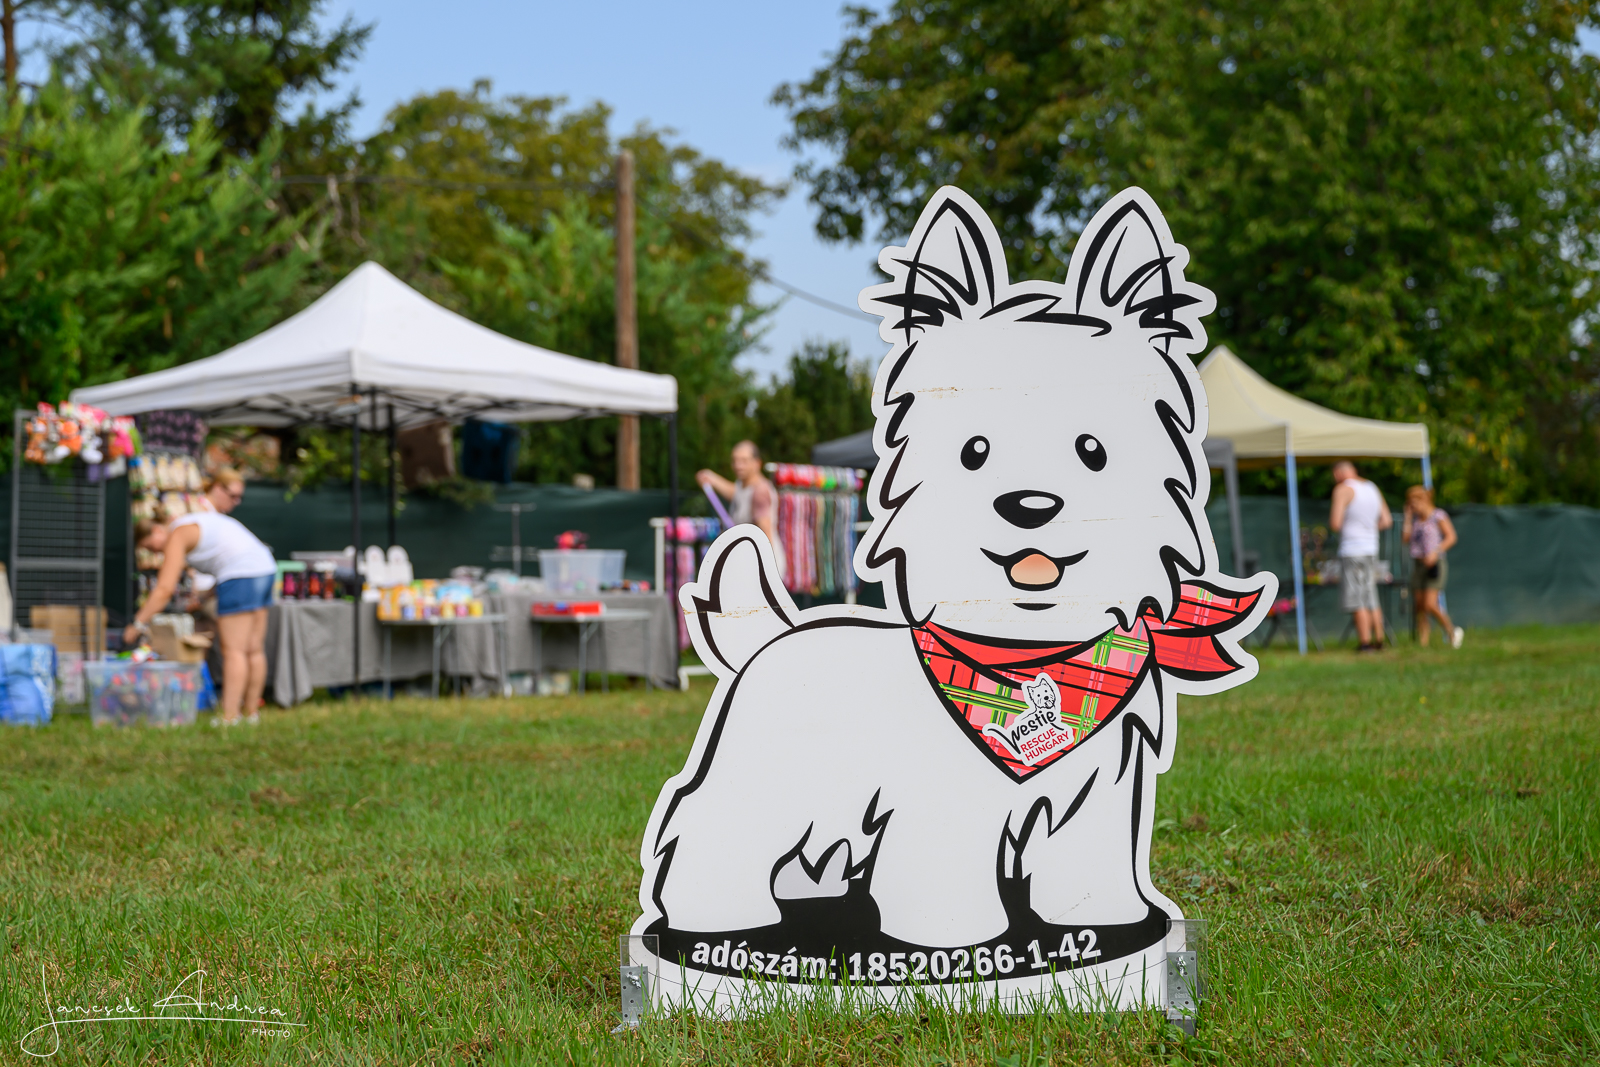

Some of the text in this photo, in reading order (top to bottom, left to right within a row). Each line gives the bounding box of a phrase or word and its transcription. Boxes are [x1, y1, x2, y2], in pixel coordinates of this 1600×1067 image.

[987, 710, 1065, 754] Westie
[1020, 728, 1057, 753] RESCUE
[1024, 731, 1070, 762] HUNGARY
[691, 929, 1102, 982] adószám: 18520266-1-42
